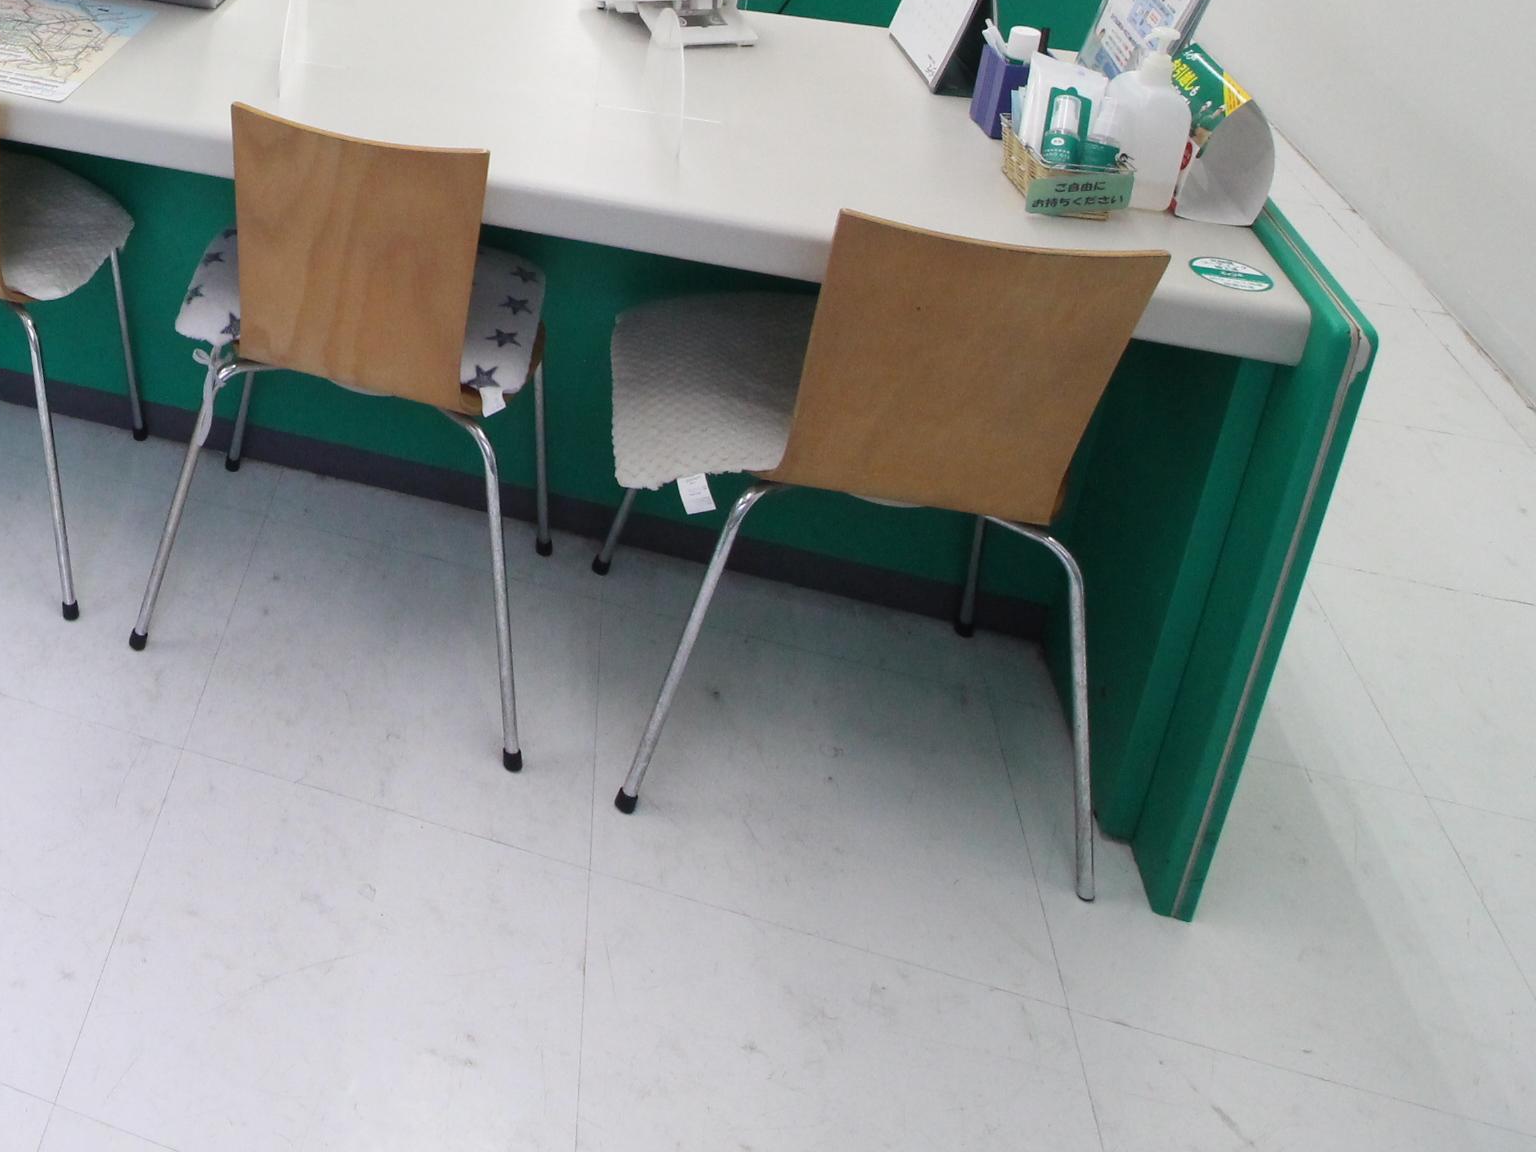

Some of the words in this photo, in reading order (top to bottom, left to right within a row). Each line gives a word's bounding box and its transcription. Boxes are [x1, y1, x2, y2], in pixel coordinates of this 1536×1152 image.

[1055, 181, 1106, 192] ご自由に
[1032, 195, 1124, 208] お持ちください
